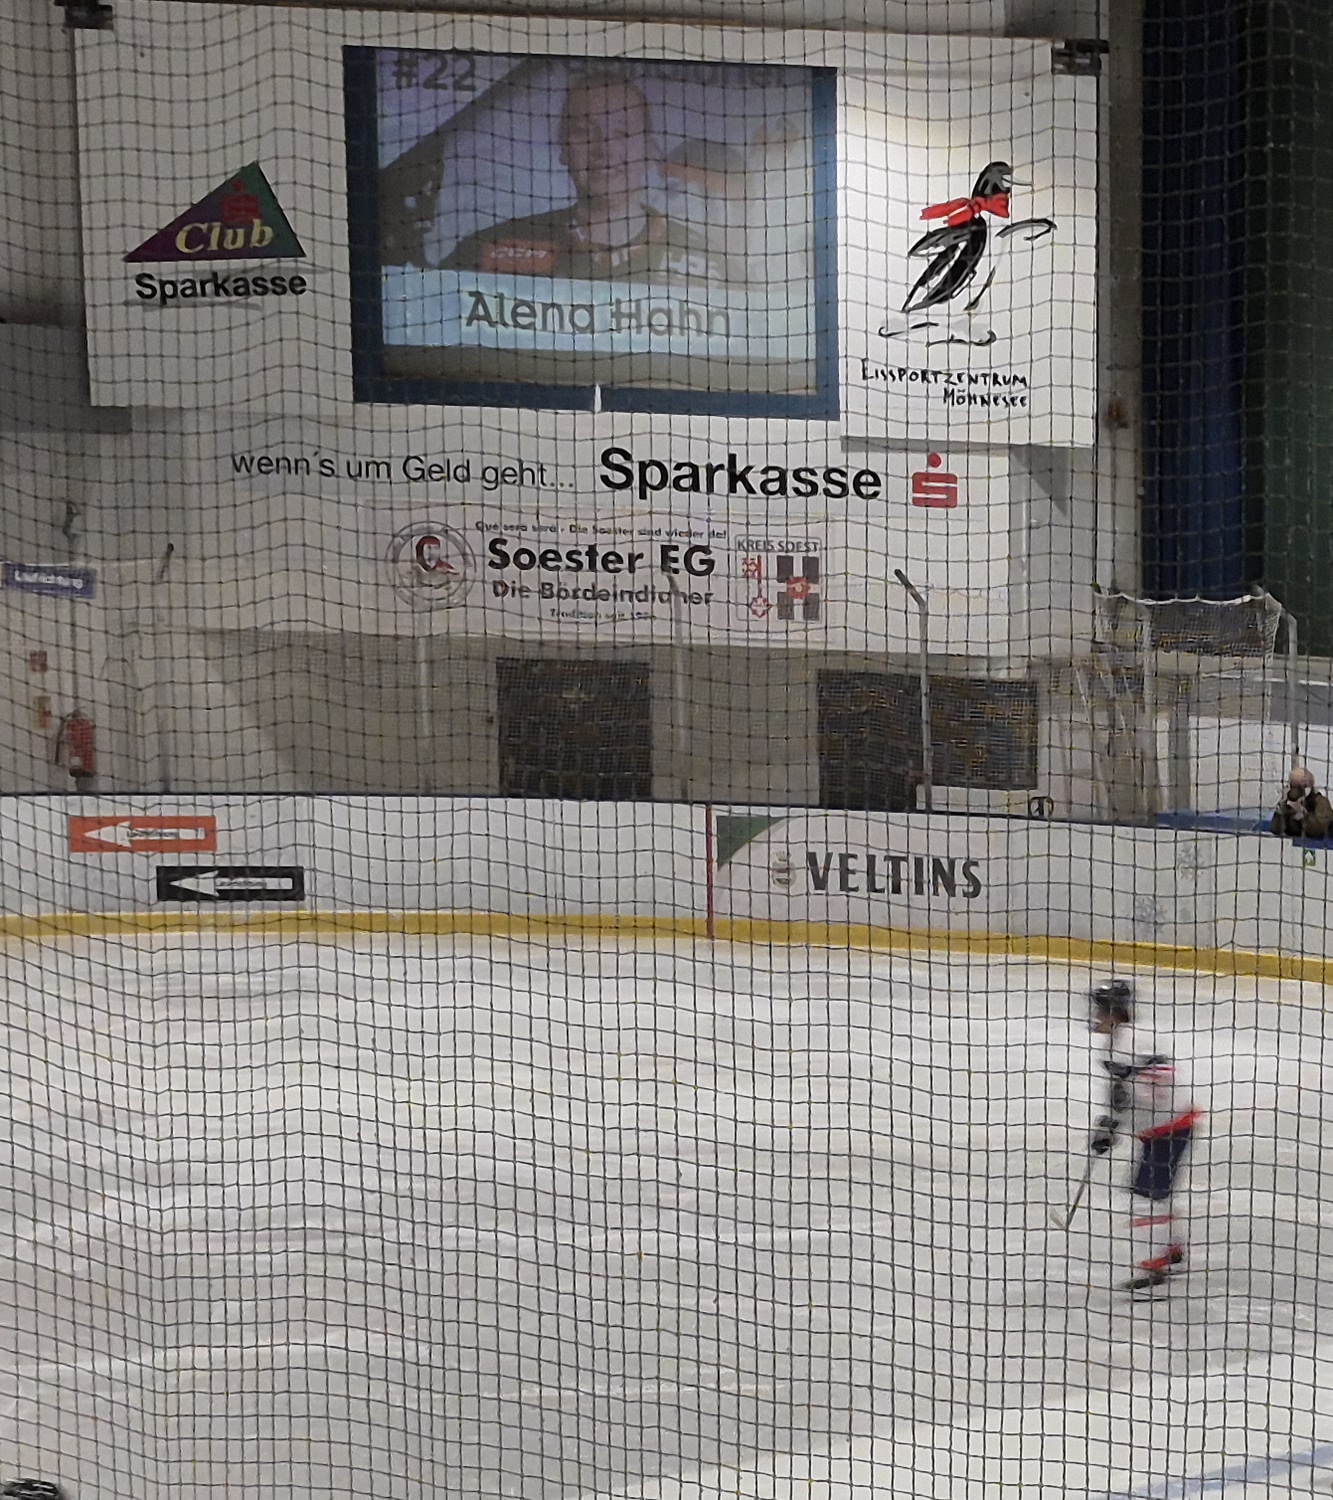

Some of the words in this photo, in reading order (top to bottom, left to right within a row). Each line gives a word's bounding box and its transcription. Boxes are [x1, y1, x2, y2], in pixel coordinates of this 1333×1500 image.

[175, 219, 274, 254] Club
[135, 272, 307, 305] Sparkasse
[465, 290, 595, 332] Alena
[612, 298, 730, 337] Hahn
[347, 460, 391, 480] um
[402, 455, 471, 483] Geld
[600, 447, 882, 500] Sparkasse
[488, 537, 644, 574] Soester
[659, 543, 716, 578] EG
[492, 580, 531, 598] Die
[806, 851, 982, 899] VELTINS
